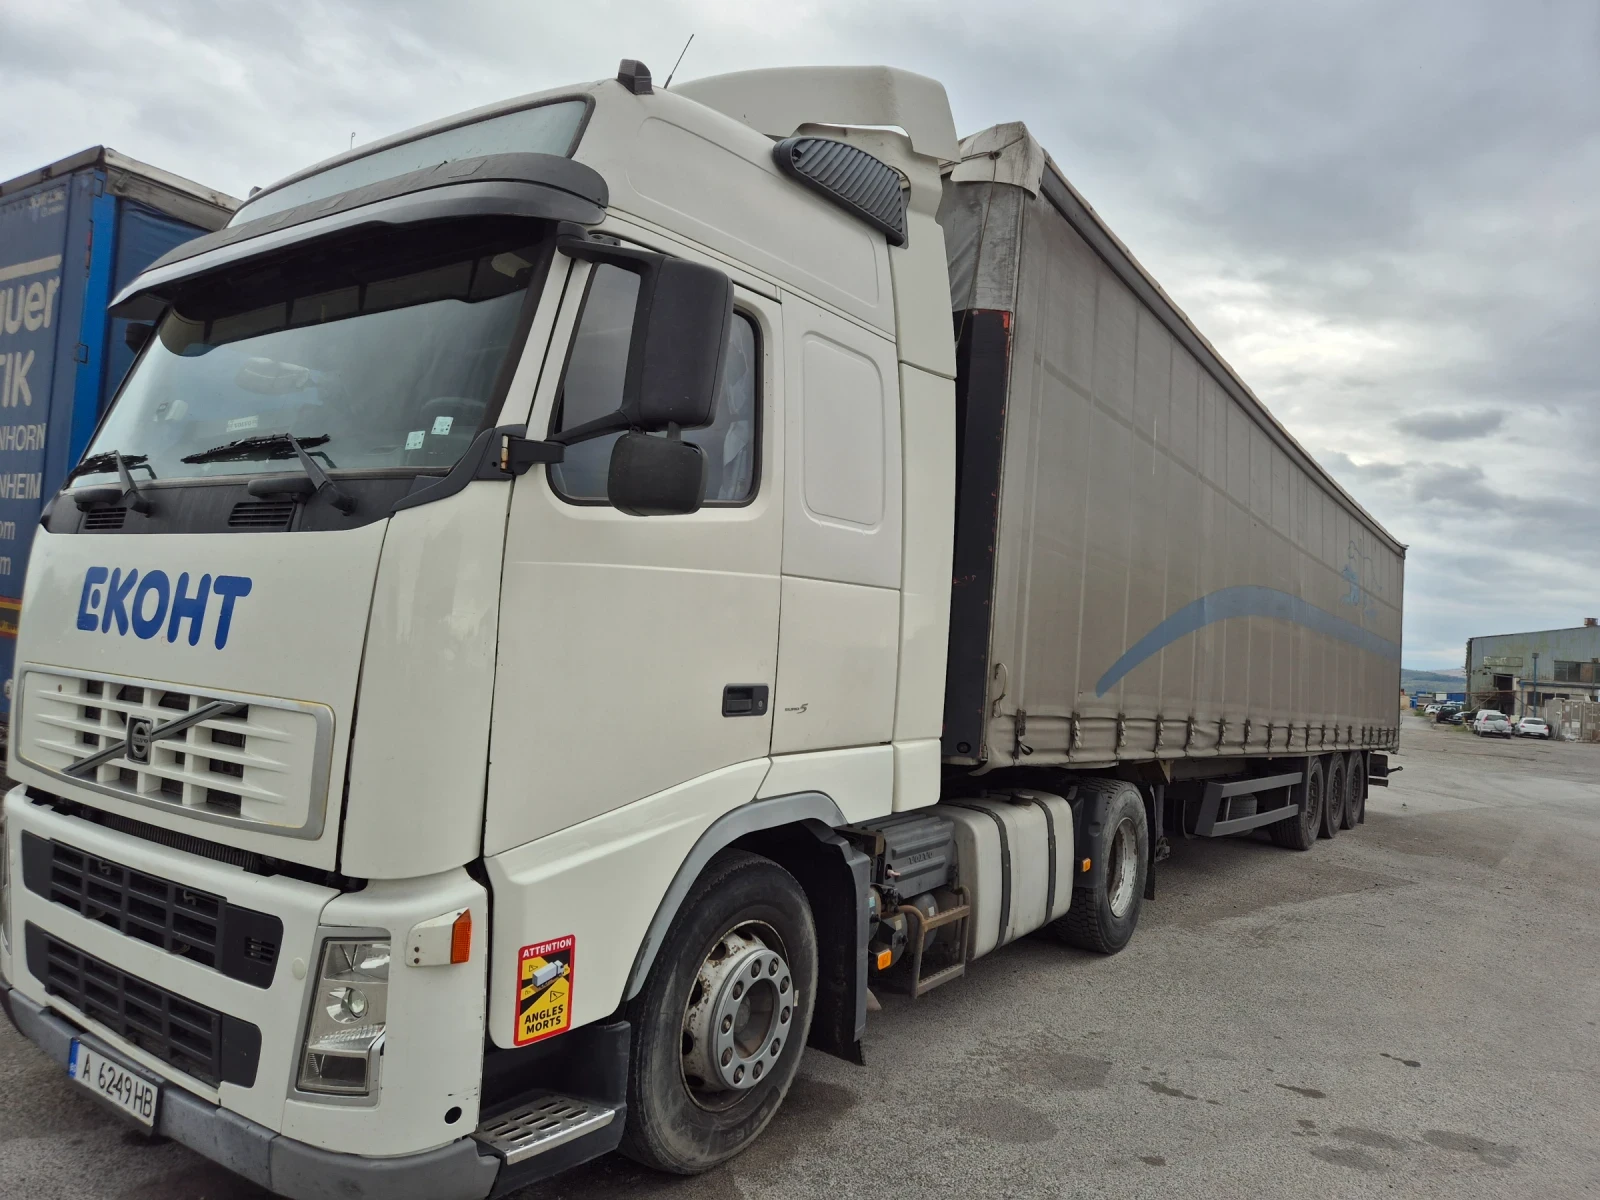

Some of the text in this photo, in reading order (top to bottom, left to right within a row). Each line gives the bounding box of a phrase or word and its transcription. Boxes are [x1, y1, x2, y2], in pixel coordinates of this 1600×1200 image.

[77, 566, 252, 650] ЕКОНТ
[908, 852, 934, 865] VOLVO
[523, 938, 572, 958] ATTENTION
[524, 1004, 564, 1024] ANGLES
[526, 1015, 562, 1035] MORTS
[82, 1053, 91, 1082] A
